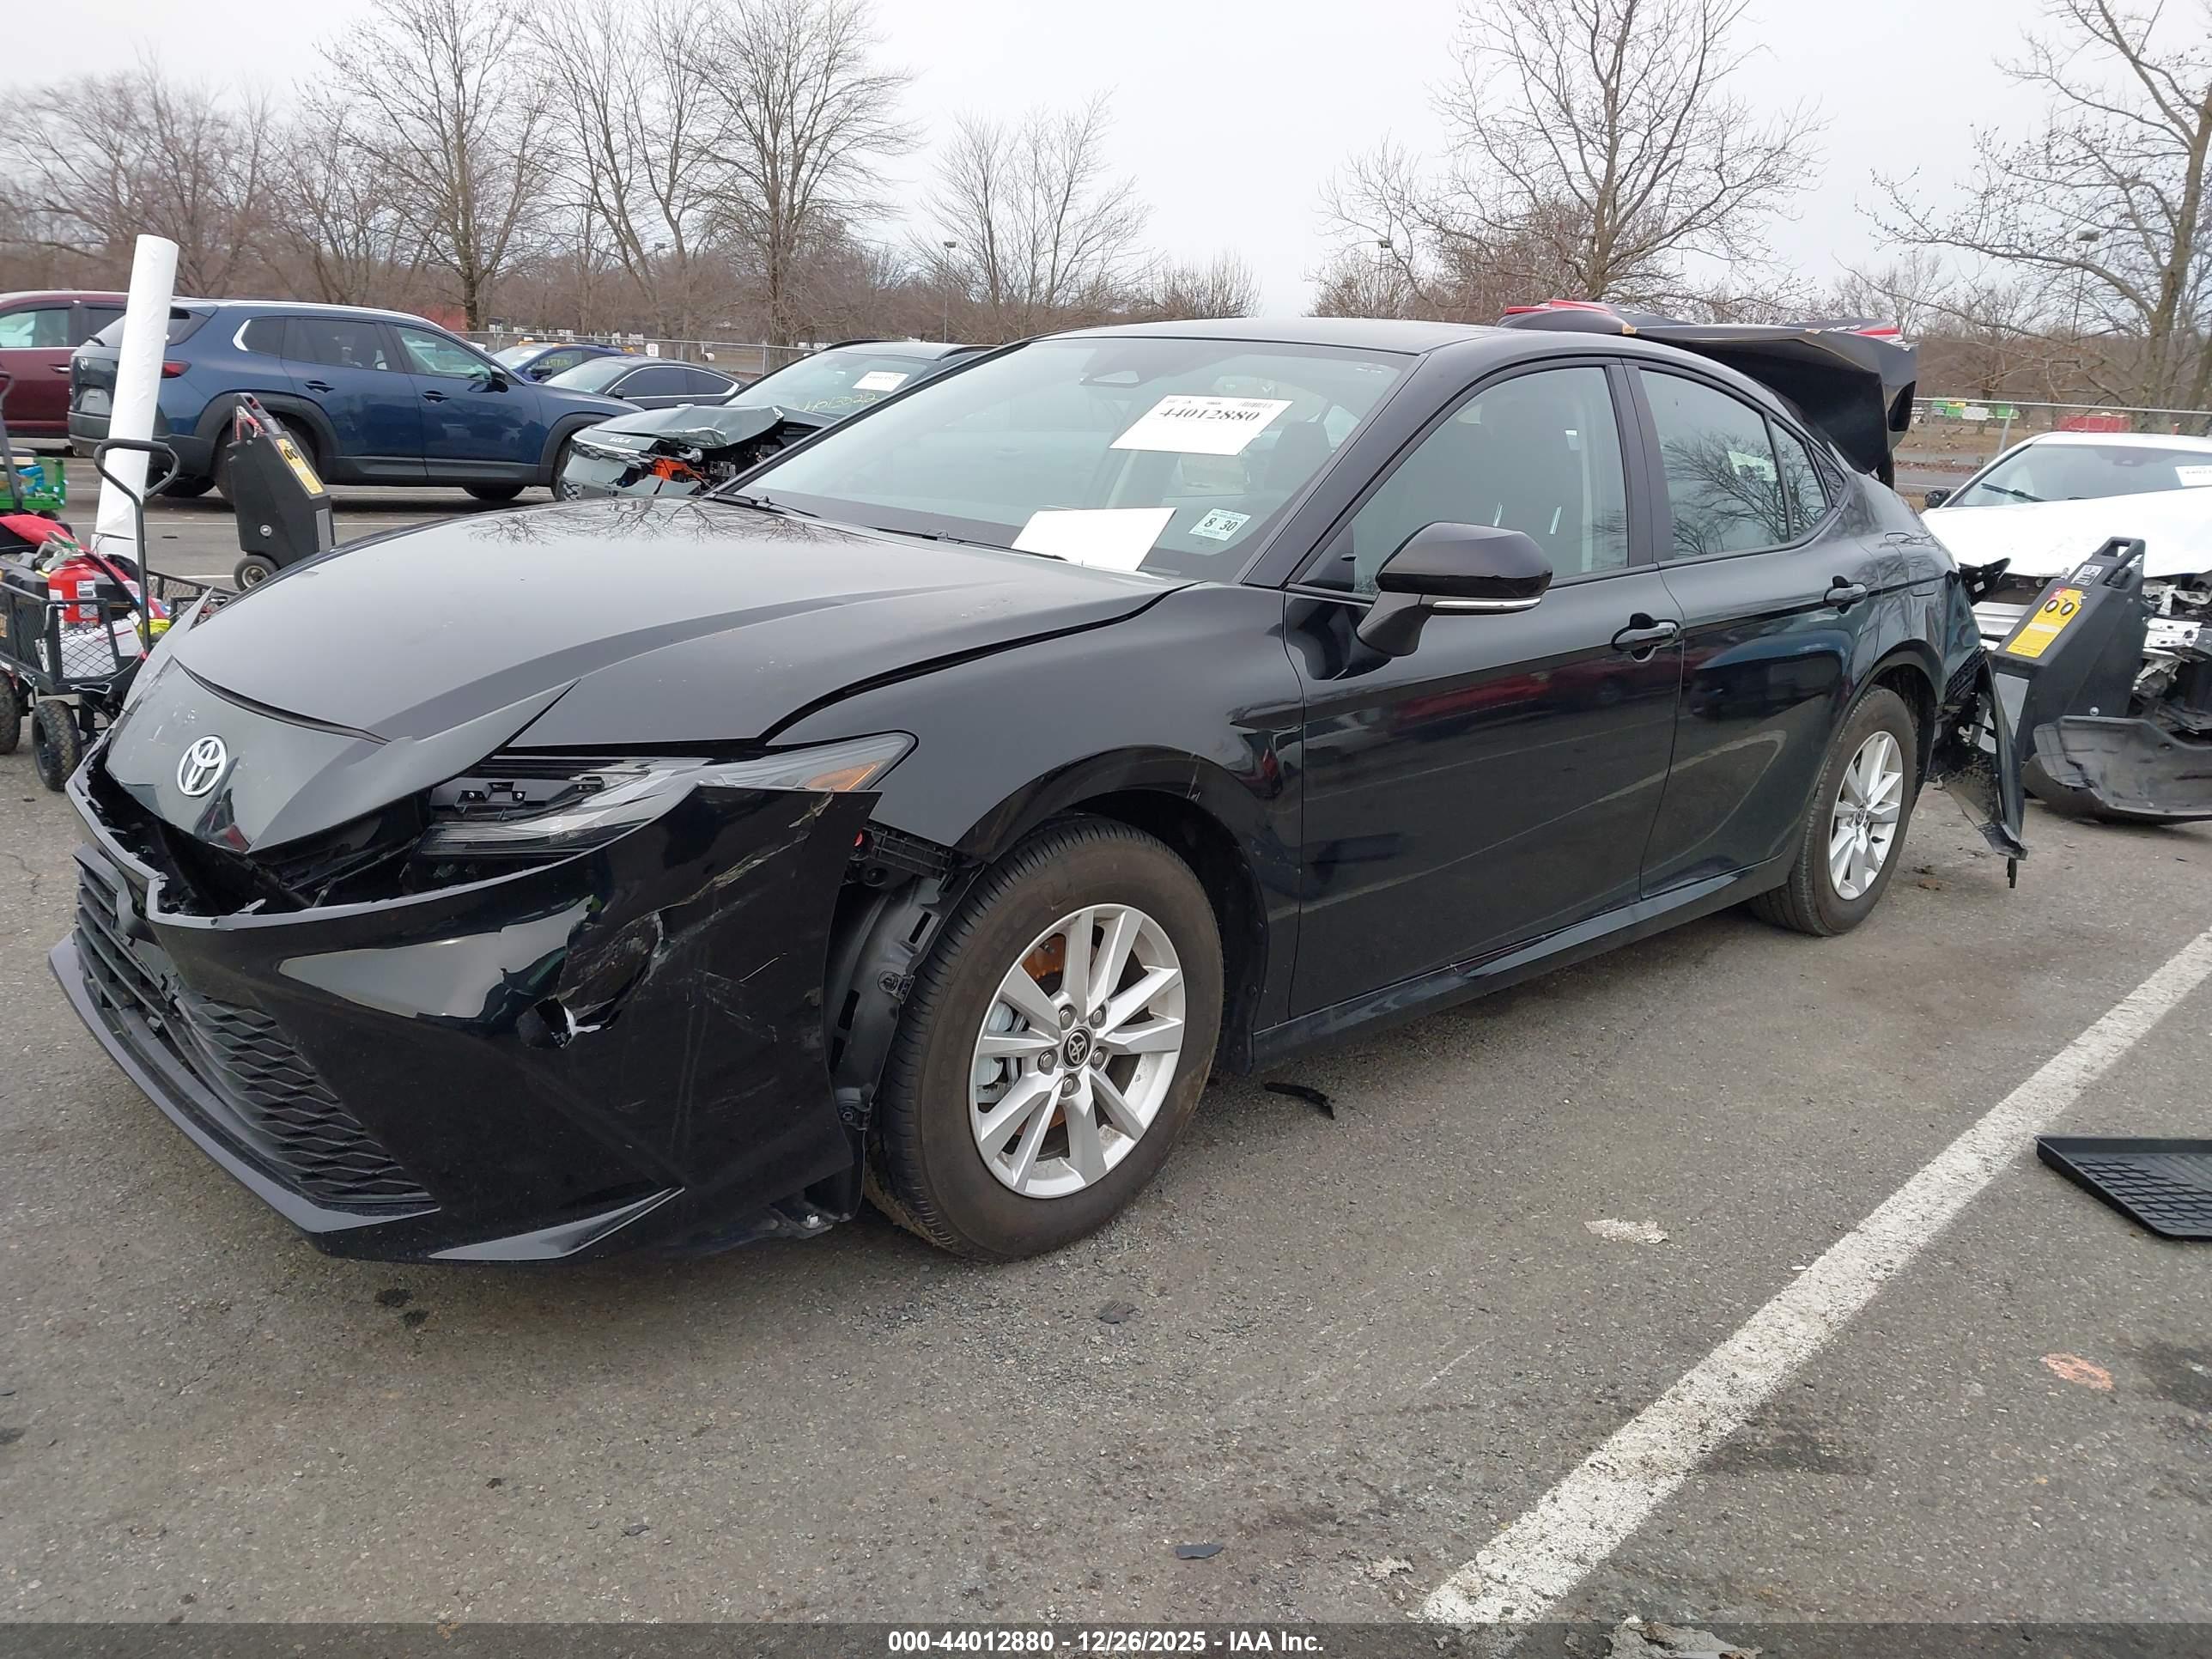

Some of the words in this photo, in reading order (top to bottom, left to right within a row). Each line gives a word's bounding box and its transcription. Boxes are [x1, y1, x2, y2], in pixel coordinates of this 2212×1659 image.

[1159, 407, 1261, 422] 44012880
[1204, 517, 1218, 527] 8
[1219, 520, 1238, 532] 30
